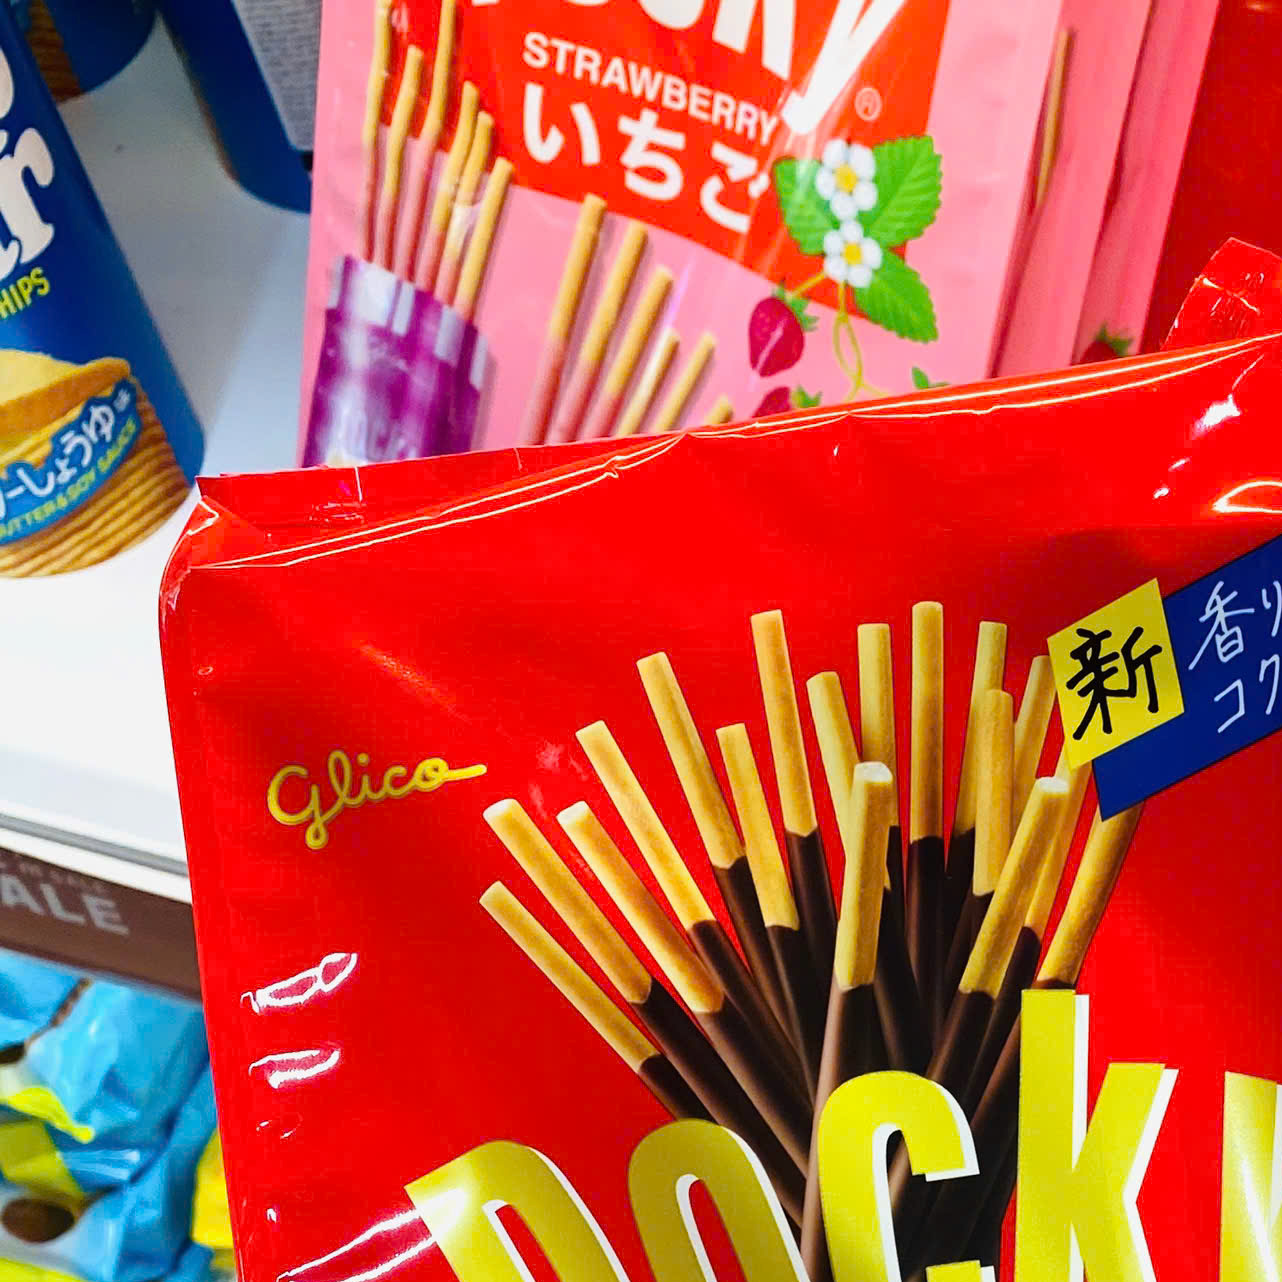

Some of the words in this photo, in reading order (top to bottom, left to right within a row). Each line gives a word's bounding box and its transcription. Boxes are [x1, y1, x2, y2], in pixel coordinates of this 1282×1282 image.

[522, 32, 780, 146] STRAWBERRY
[523, 83, 769, 234] いちご
[1066, 627, 1163, 741] 新
[0, 875, 129, 936] ALE
